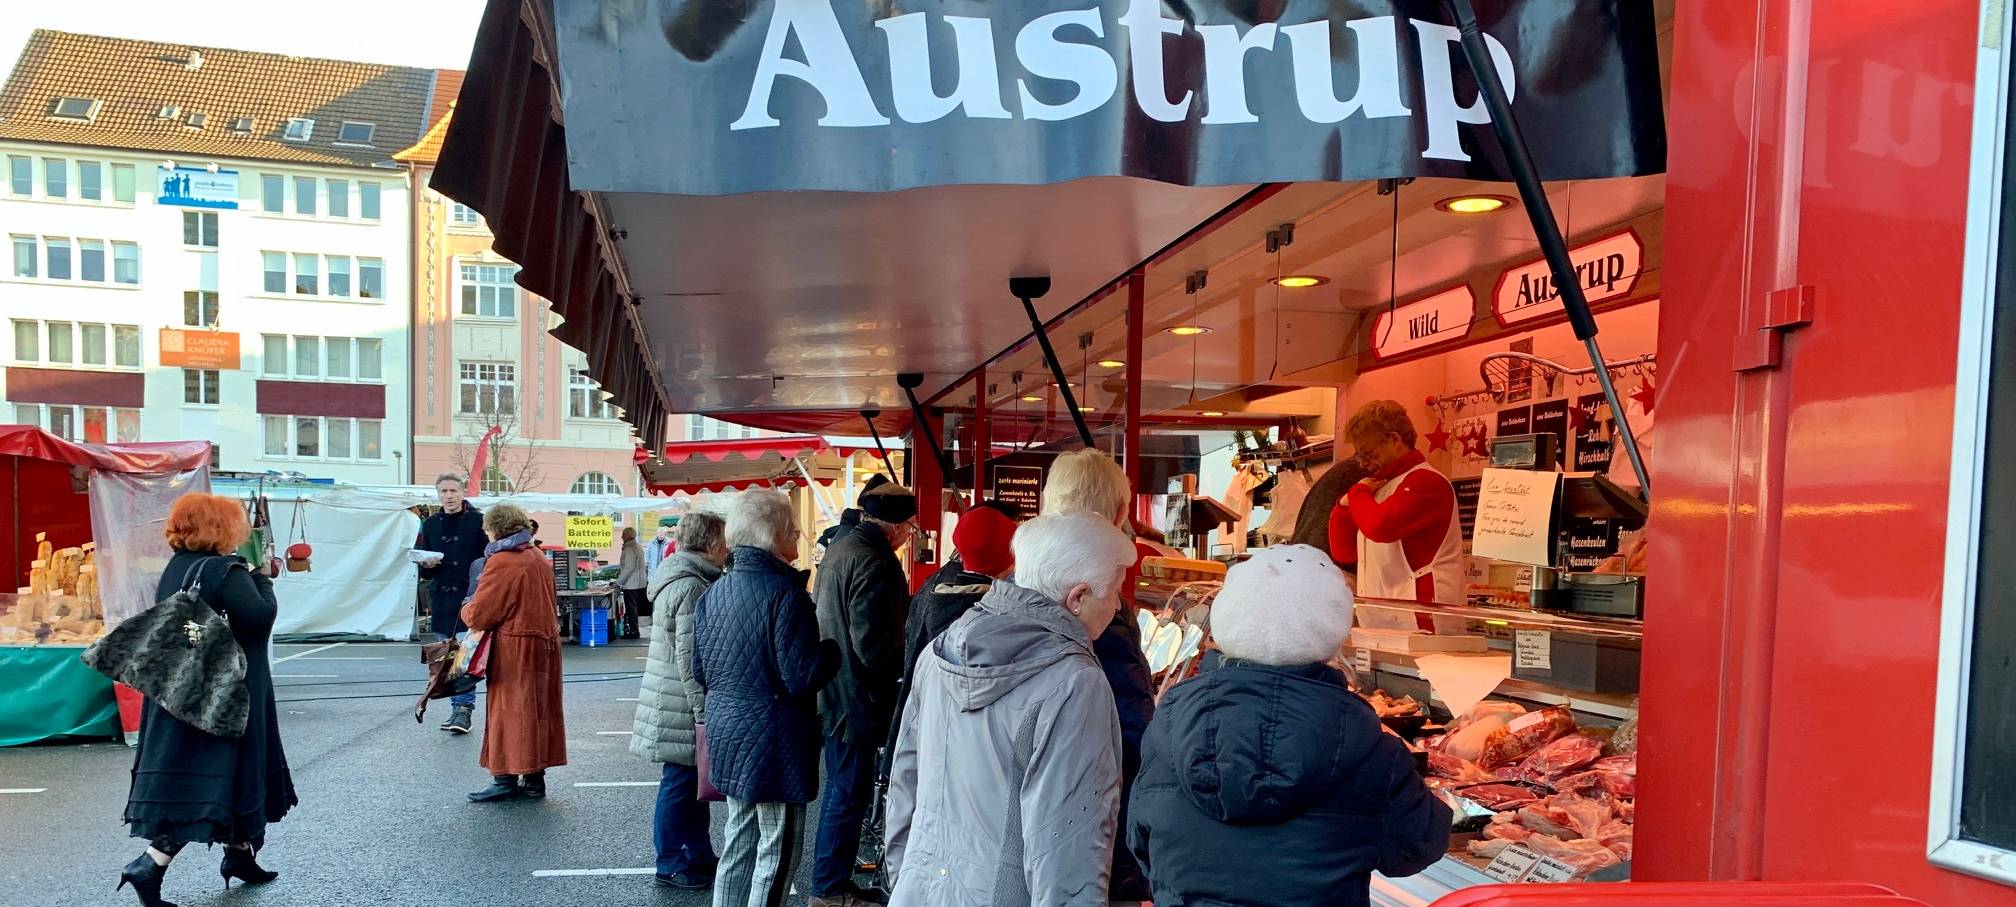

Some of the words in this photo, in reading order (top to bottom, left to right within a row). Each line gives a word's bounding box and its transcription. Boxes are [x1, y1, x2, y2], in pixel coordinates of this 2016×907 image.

[731, 0, 1517, 162] Austrup
[1514, 252, 1625, 309] Ausrup
[1408, 309, 1439, 340] Wild
[573, 517, 606, 526] Sofort
[568, 528, 612, 537] Batterie
[567, 540, 612, 548] Wechsel
[1570, 535, 1607, 550] Hasenkeulen
